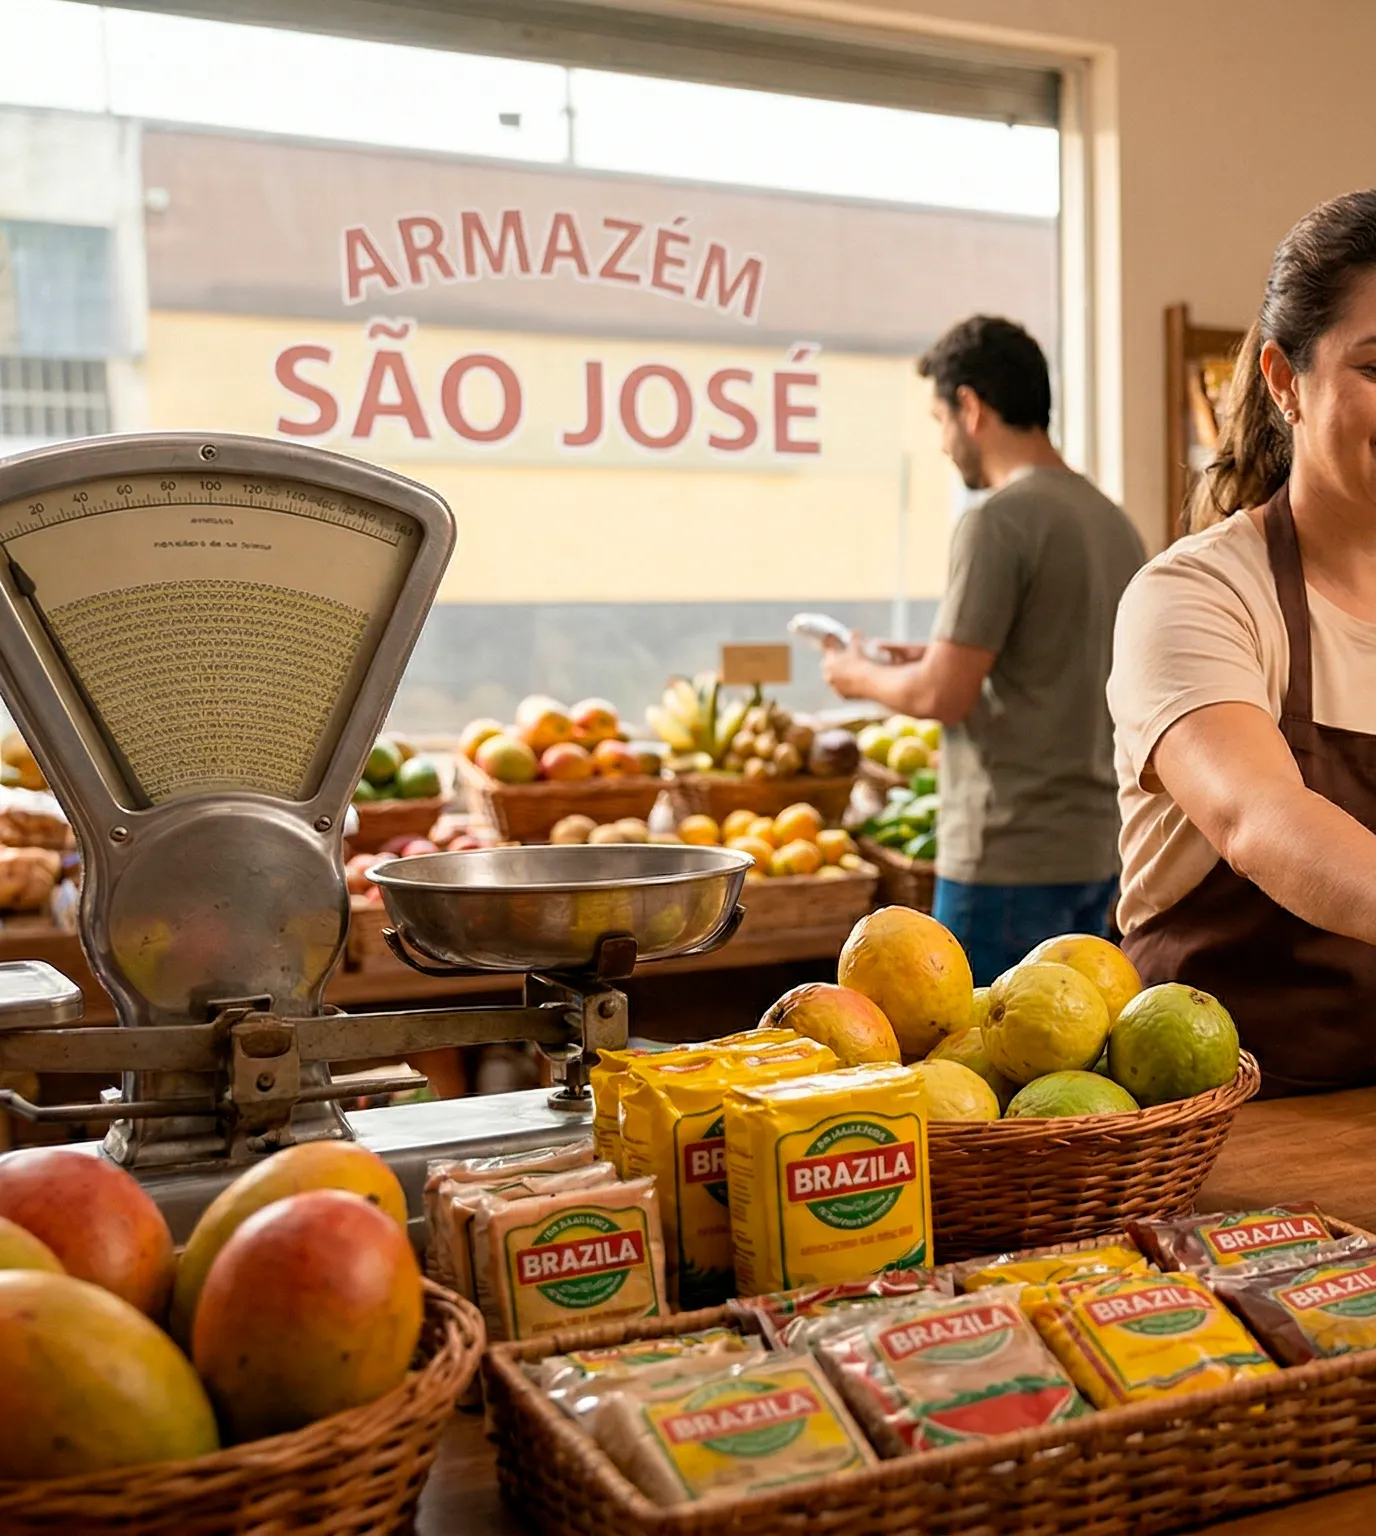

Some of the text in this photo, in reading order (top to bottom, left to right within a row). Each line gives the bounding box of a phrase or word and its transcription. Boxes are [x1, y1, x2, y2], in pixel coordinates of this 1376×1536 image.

[344, 209, 763, 318] ARMAZÉM
[275, 323, 821, 454] SÃO JOSÉ
[28, 502, 45, 516] 20
[73, 491, 89, 504] 40
[116, 484, 133, 496] 60
[199, 480, 222, 491] 100
[243, 484, 263, 495] 120
[794, 1151, 911, 1195] BRAZILA
[1216, 1219, 1322, 1250] BRAZILA
[522, 1238, 639, 1278] BRAZILA
[1090, 1287, 1211, 1322] BRAZILA
[888, 1308, 1012, 1354] BRAZILA
[670, 1392, 814, 1440] BRAZILA
